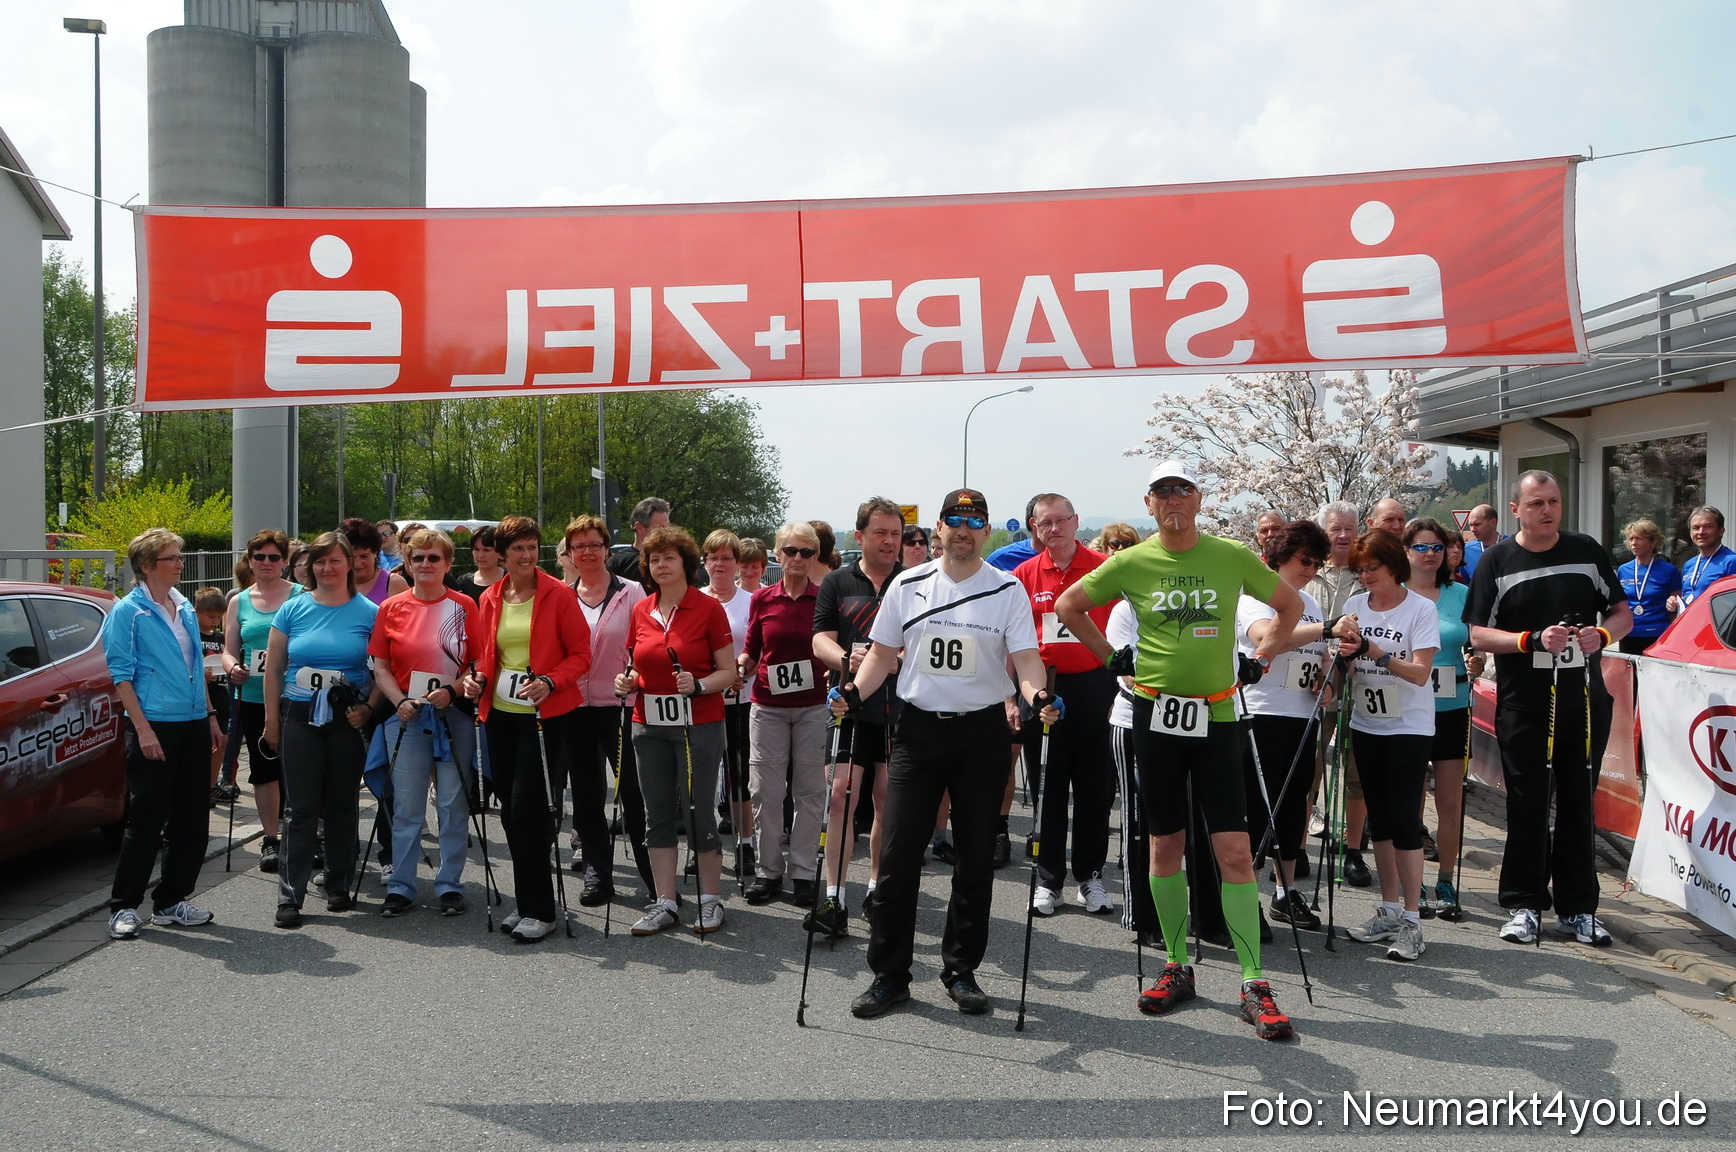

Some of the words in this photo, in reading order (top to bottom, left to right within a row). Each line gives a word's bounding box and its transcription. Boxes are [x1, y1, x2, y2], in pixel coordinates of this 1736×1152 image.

[1160, 575, 1205, 588] FÜRTH
[1151, 589, 1218, 612] 2012
[929, 620, 1000, 634] www.fitness-neumarkt.de
[930, 637, 963, 670] 96
[310, 673, 323, 691] 9
[776, 663, 803, 689] 84
[655, 697, 679, 722] 10
[1365, 688, 1387, 714] 31
[1163, 698, 1198, 732] 80
[64, 743, 79, 757] Jetzt
[79, 729, 114, 750] Probefahren.
[1707, 725, 1736, 773] K
[1663, 800, 1695, 844] KIA
[1669, 855, 1685, 879] The
[1717, 882, 1731, 904] to
